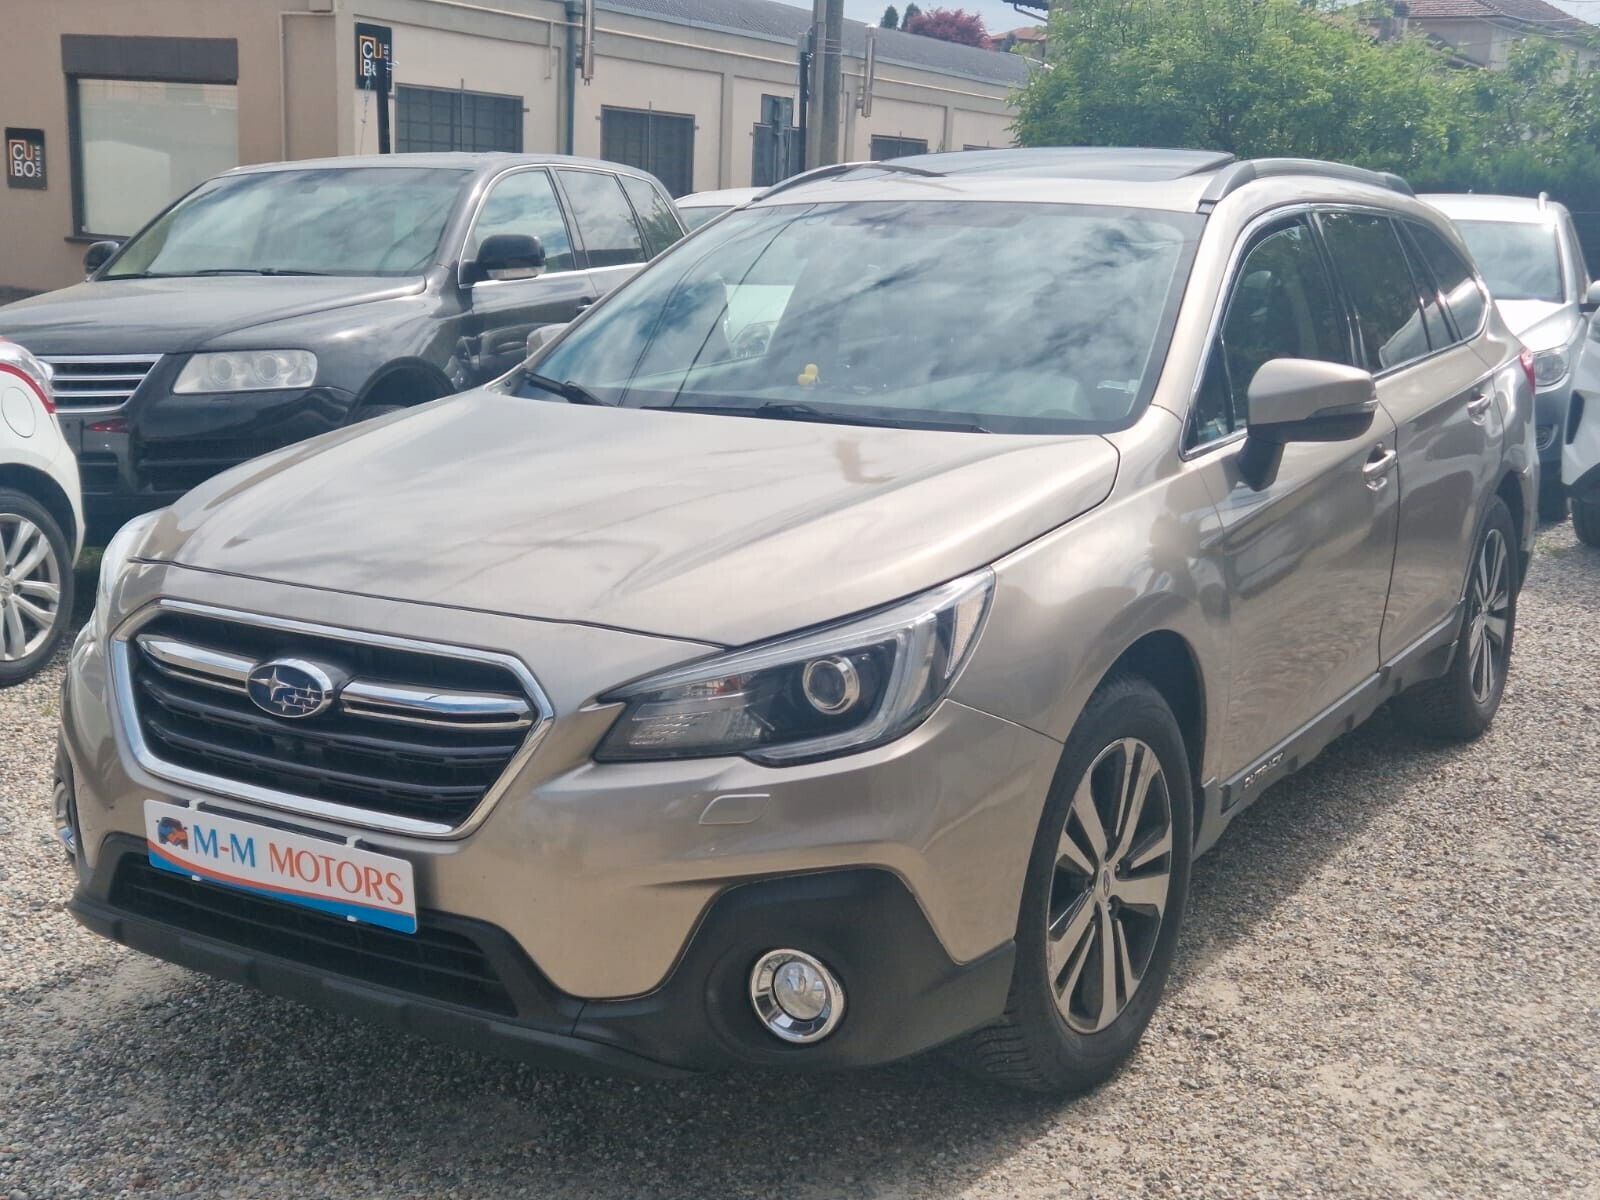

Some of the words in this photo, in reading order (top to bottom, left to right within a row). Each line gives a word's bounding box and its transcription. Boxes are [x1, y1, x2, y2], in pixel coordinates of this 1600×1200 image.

[13, 143, 33, 160] CU
[14, 160, 35, 177] BO
[192, 824, 256, 868] M-M
[268, 842, 404, 905] MOTORS
